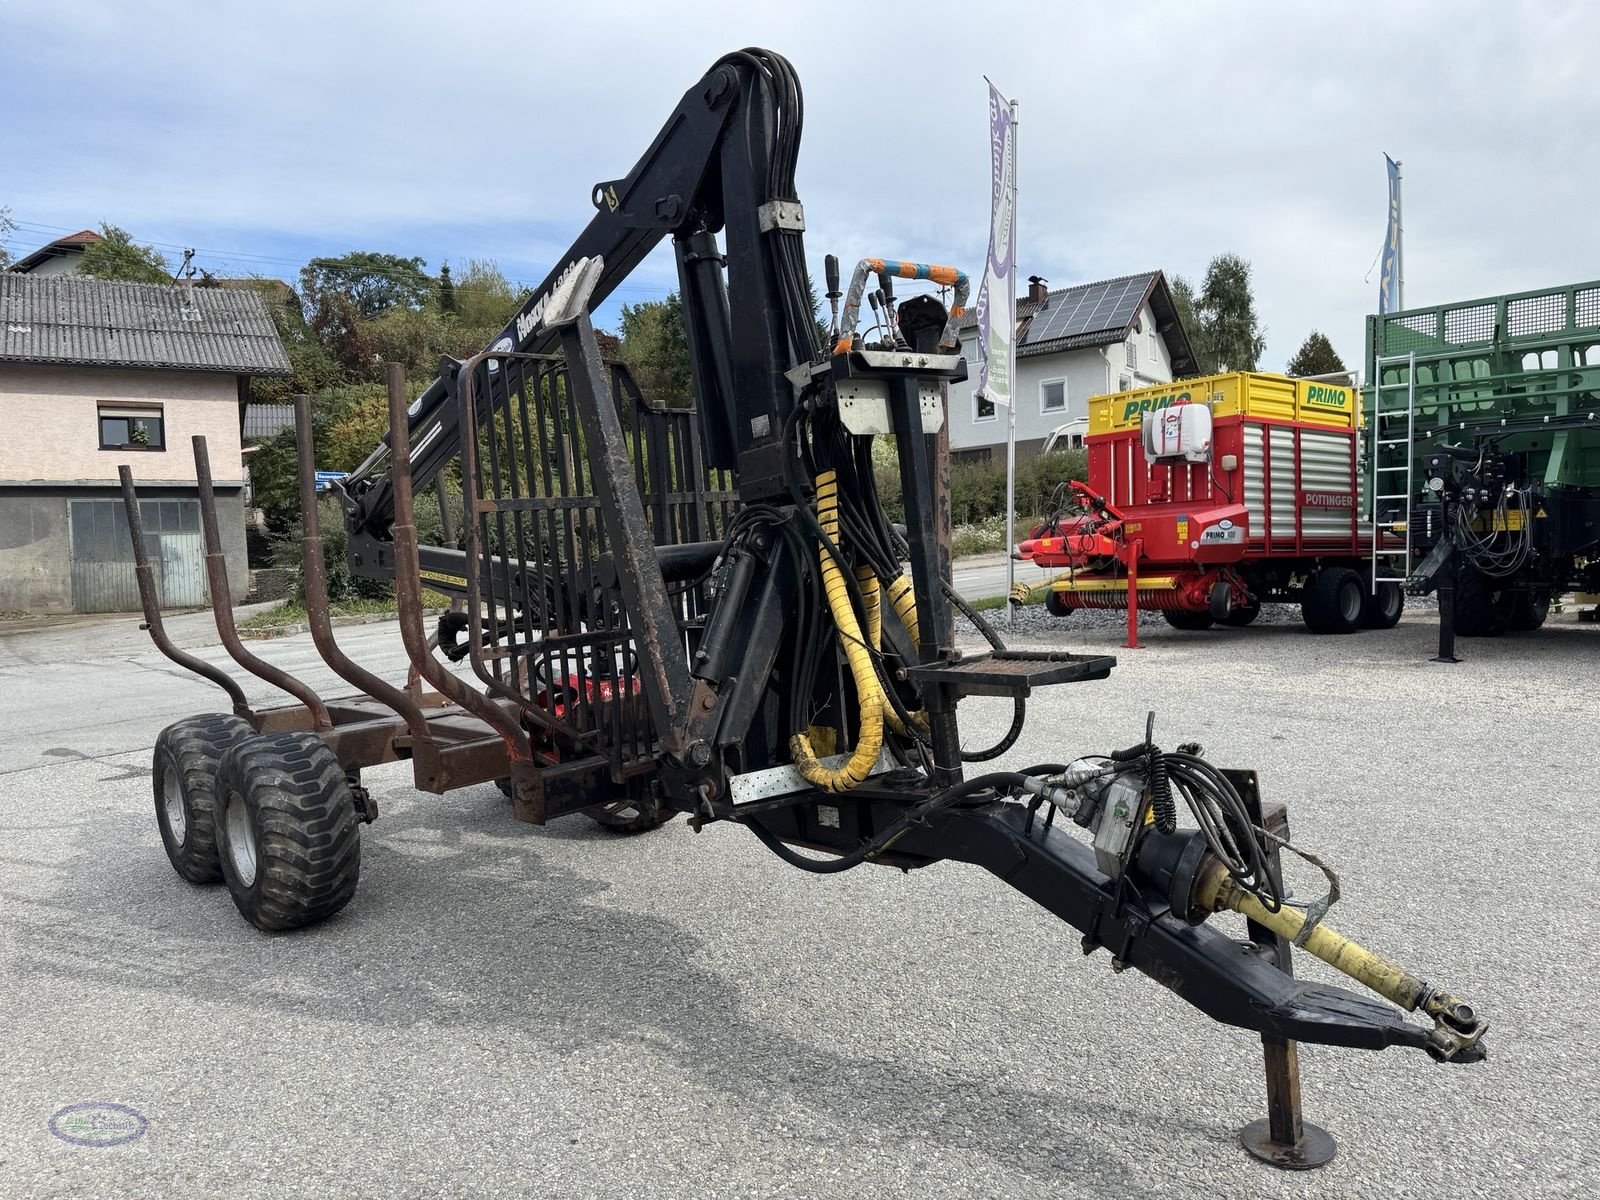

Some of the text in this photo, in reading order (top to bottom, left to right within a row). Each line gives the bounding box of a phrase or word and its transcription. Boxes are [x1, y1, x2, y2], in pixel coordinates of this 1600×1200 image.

[1307, 385, 1346, 406] PRIMO
[1123, 392, 1192, 421] PRIMO
[1205, 531, 1225, 539] PRIMO
